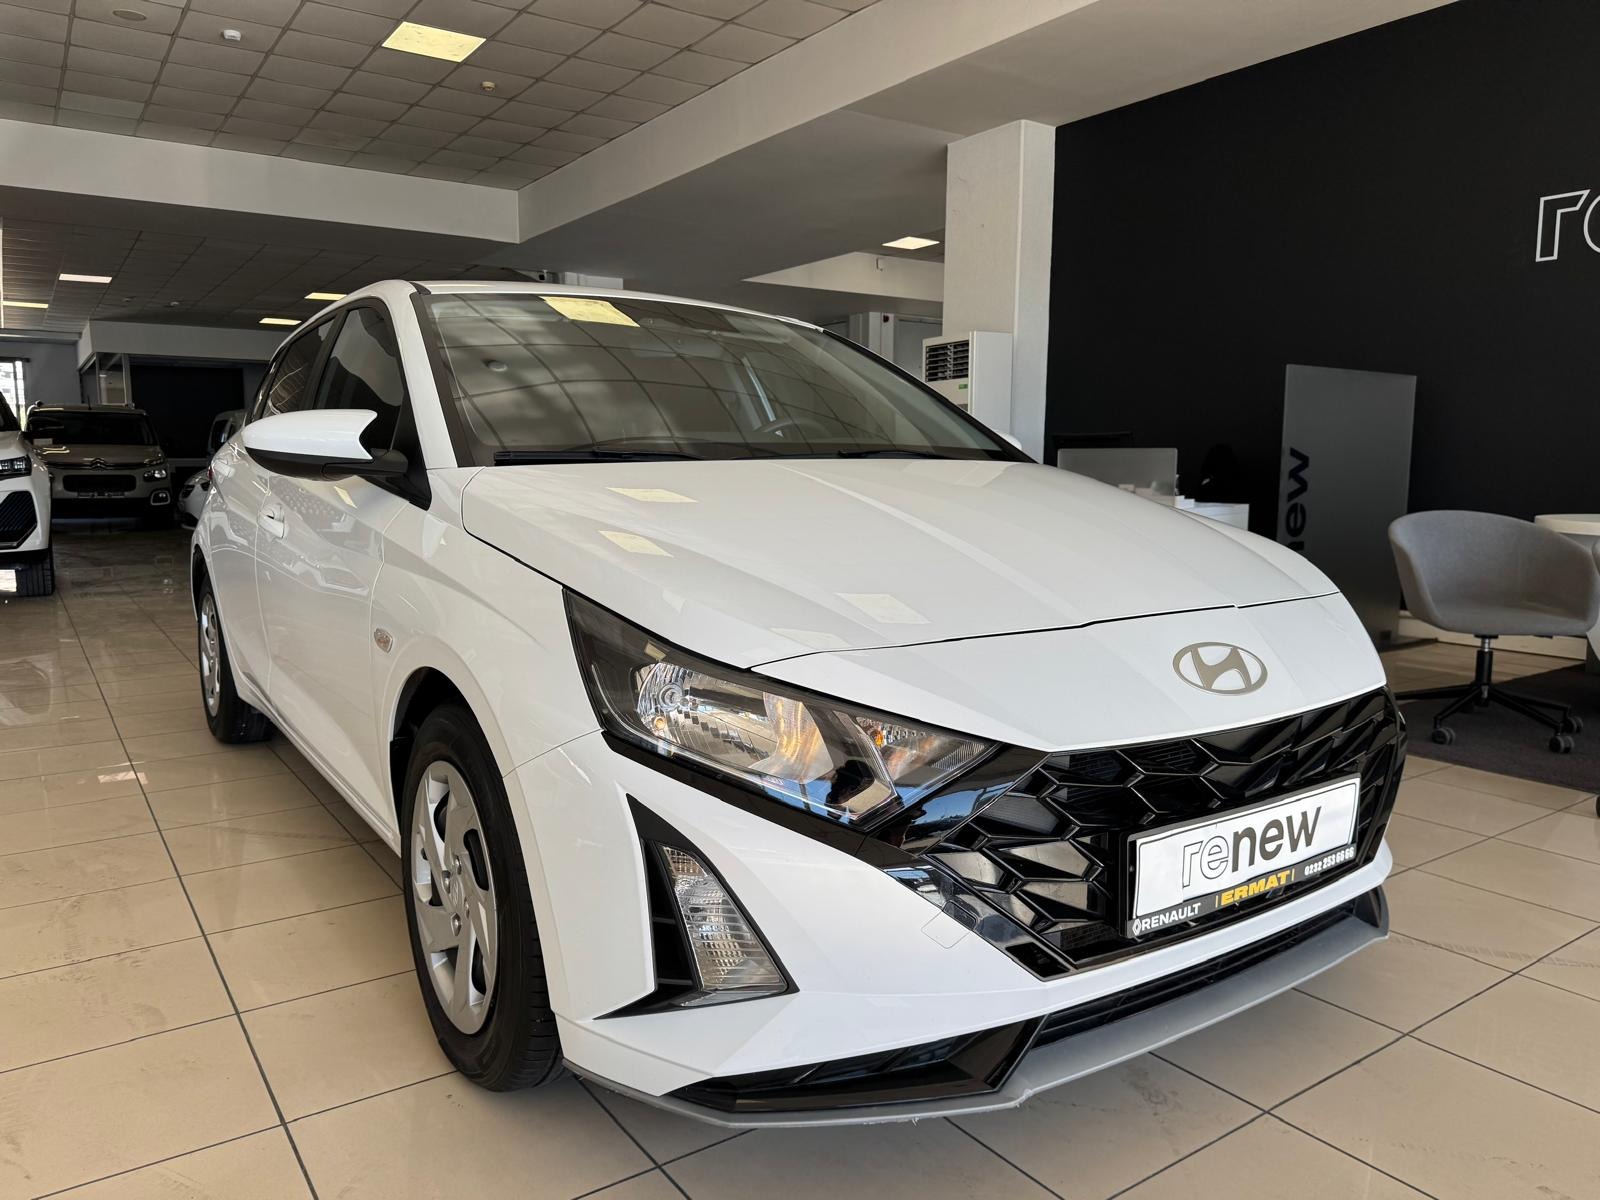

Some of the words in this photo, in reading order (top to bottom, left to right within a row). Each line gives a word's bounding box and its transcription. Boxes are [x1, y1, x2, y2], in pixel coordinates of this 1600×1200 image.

[1182, 806, 1322, 888] renew
[1141, 902, 1201, 931] RENAULT
[1220, 870, 1290, 906] ERMAT
[1304, 861, 1323, 876] 0232
